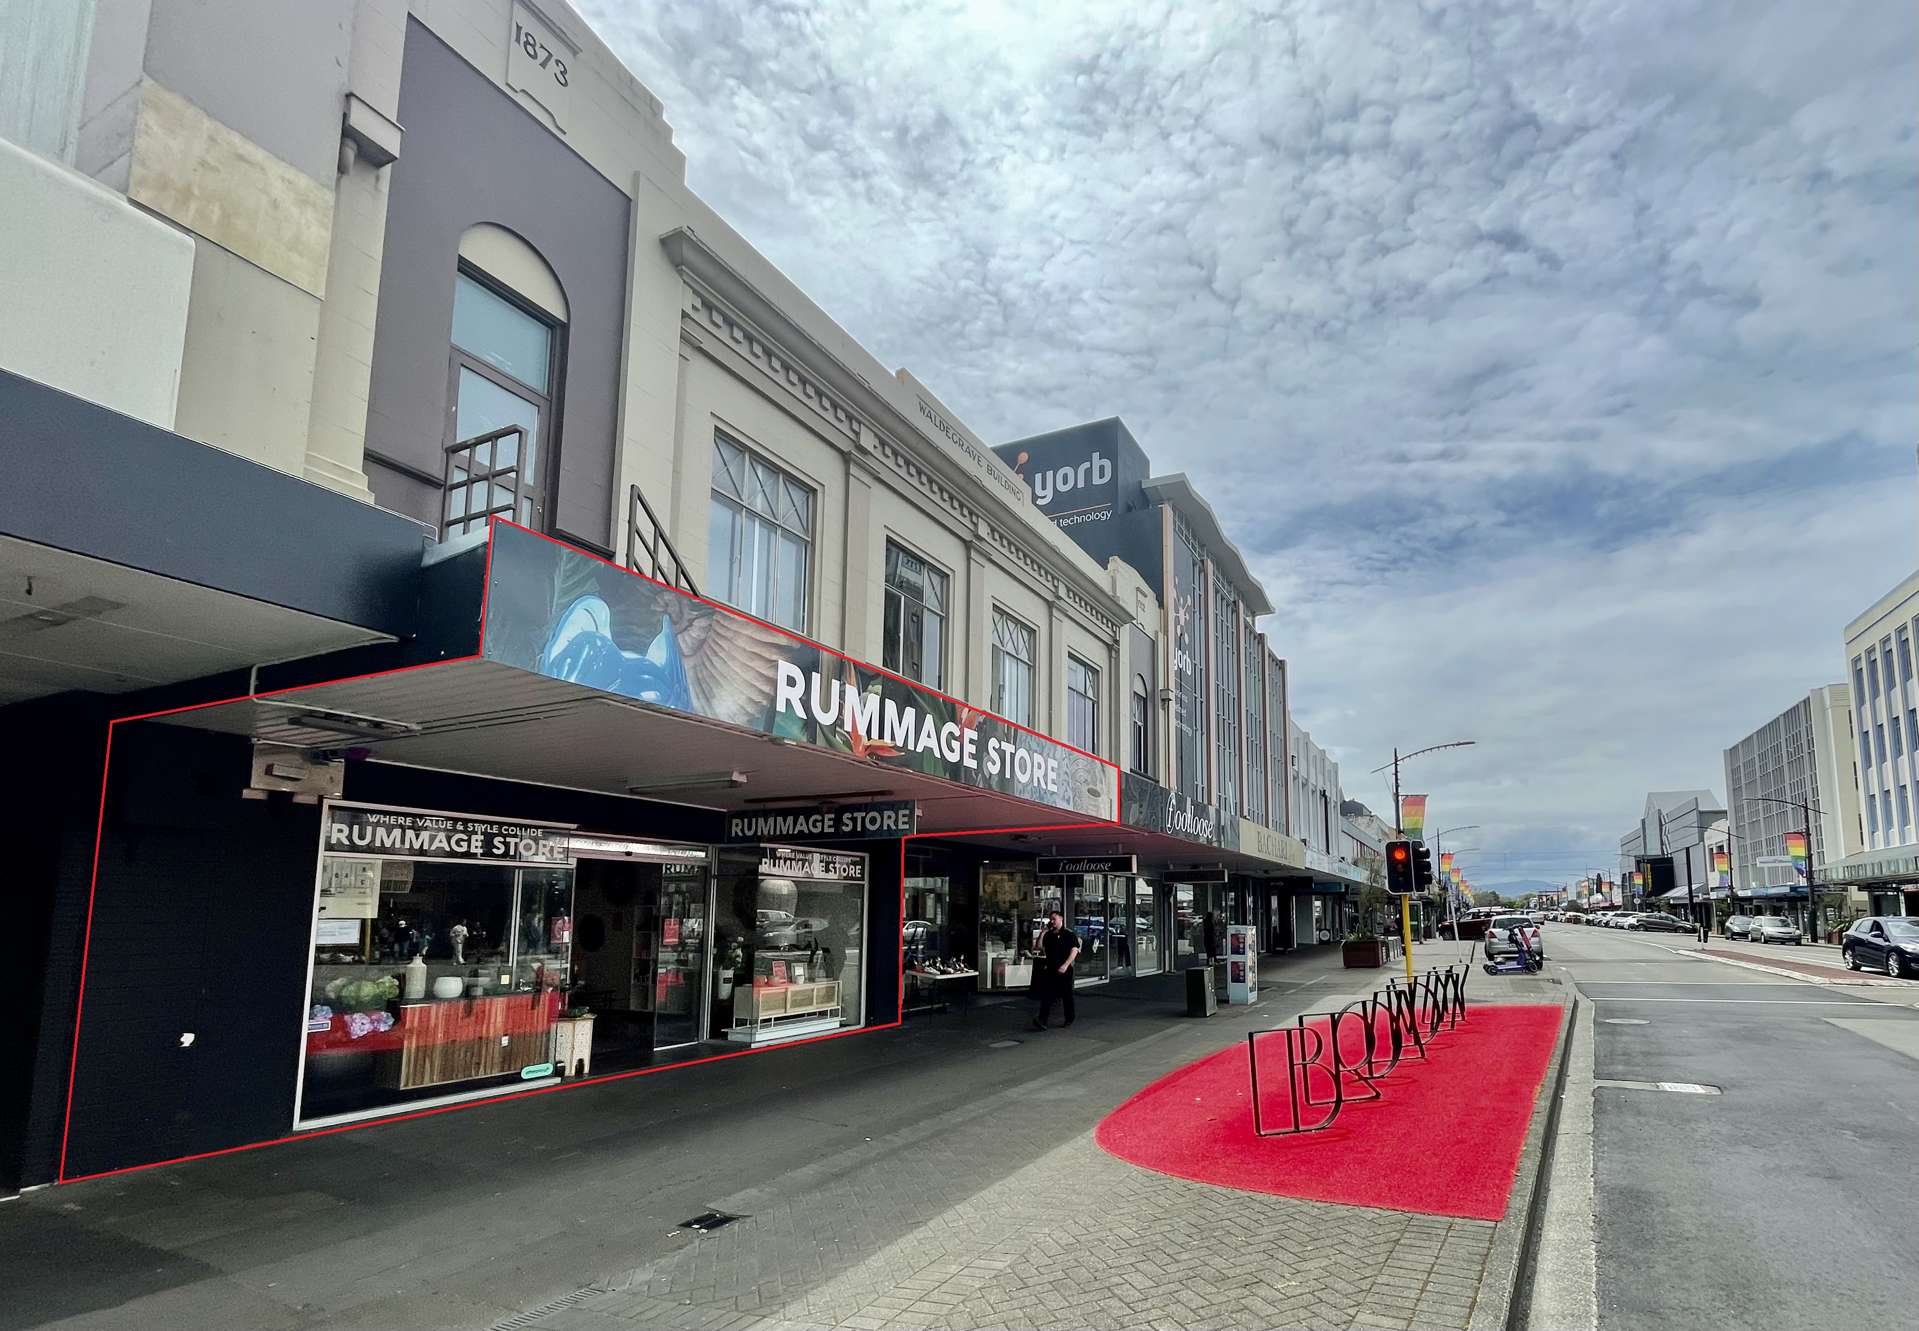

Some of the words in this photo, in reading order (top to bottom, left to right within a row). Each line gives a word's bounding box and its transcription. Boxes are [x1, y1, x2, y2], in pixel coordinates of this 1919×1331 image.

[514, 21, 569, 87] 1873
[918, 400, 983, 468] WALDEGRAVE
[986, 463, 1022, 501] BUILDING
[1034, 451, 1112, 505] yorb
[1060, 509, 1113, 527] technology
[776, 659, 978, 769] RUMMAGE
[986, 737, 1058, 793] STORE
[330, 823, 483, 854] RUMMAGE
[492, 836, 566, 859] STORE
[367, 813, 413, 826] WHERE
[416, 817, 453, 830] VALUE
[456, 821, 464, 830] &
[467, 822, 500, 834] STYLE
[502, 825, 543, 837] COLLIDE
[731, 813, 835, 837] RUMMAGE
[842, 809, 910, 833] STORE
[829, 863, 862, 878] STORE
